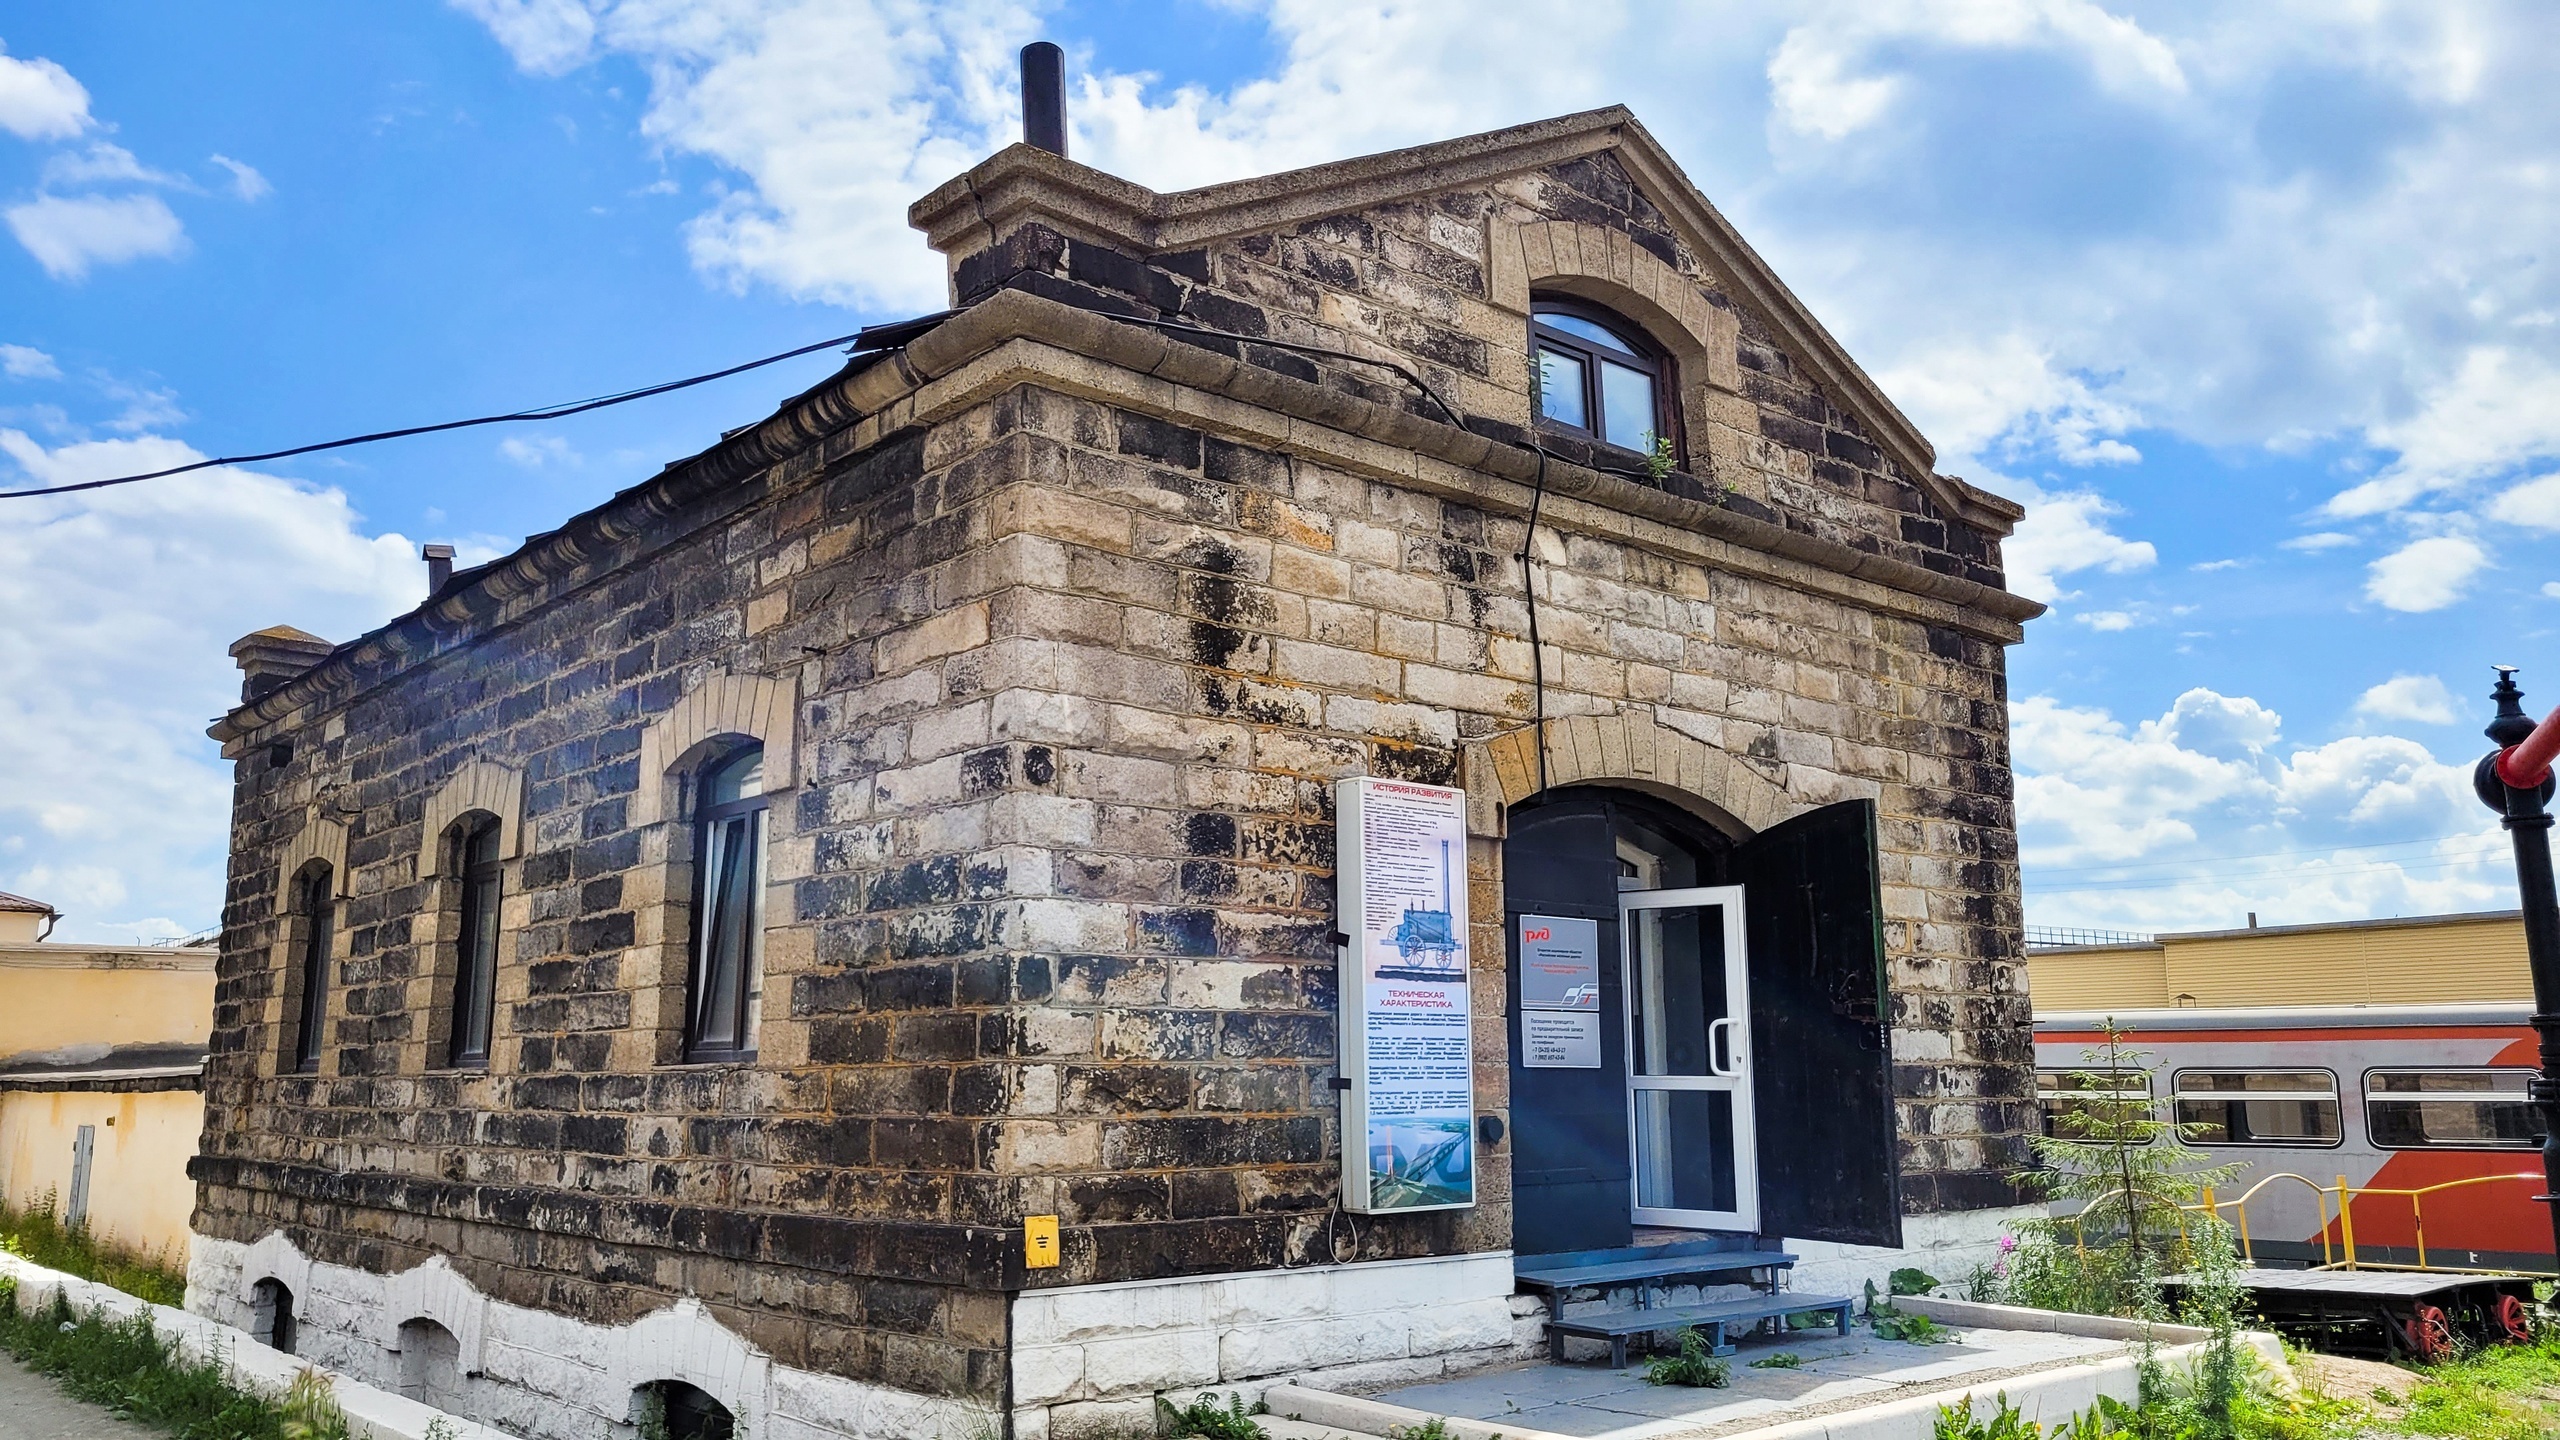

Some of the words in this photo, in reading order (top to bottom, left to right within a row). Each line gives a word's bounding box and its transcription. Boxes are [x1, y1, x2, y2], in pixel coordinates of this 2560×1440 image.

[1372, 783, 1410, 794] ИСТОРИЯ
[1411, 788, 1452, 799] РАЗВИТИЯ
[1388, 990, 1445, 998] ТЕХНИЧЕСКАЯ
[1380, 999, 1453, 1008] ХАРАКТЕРИСТИКА
